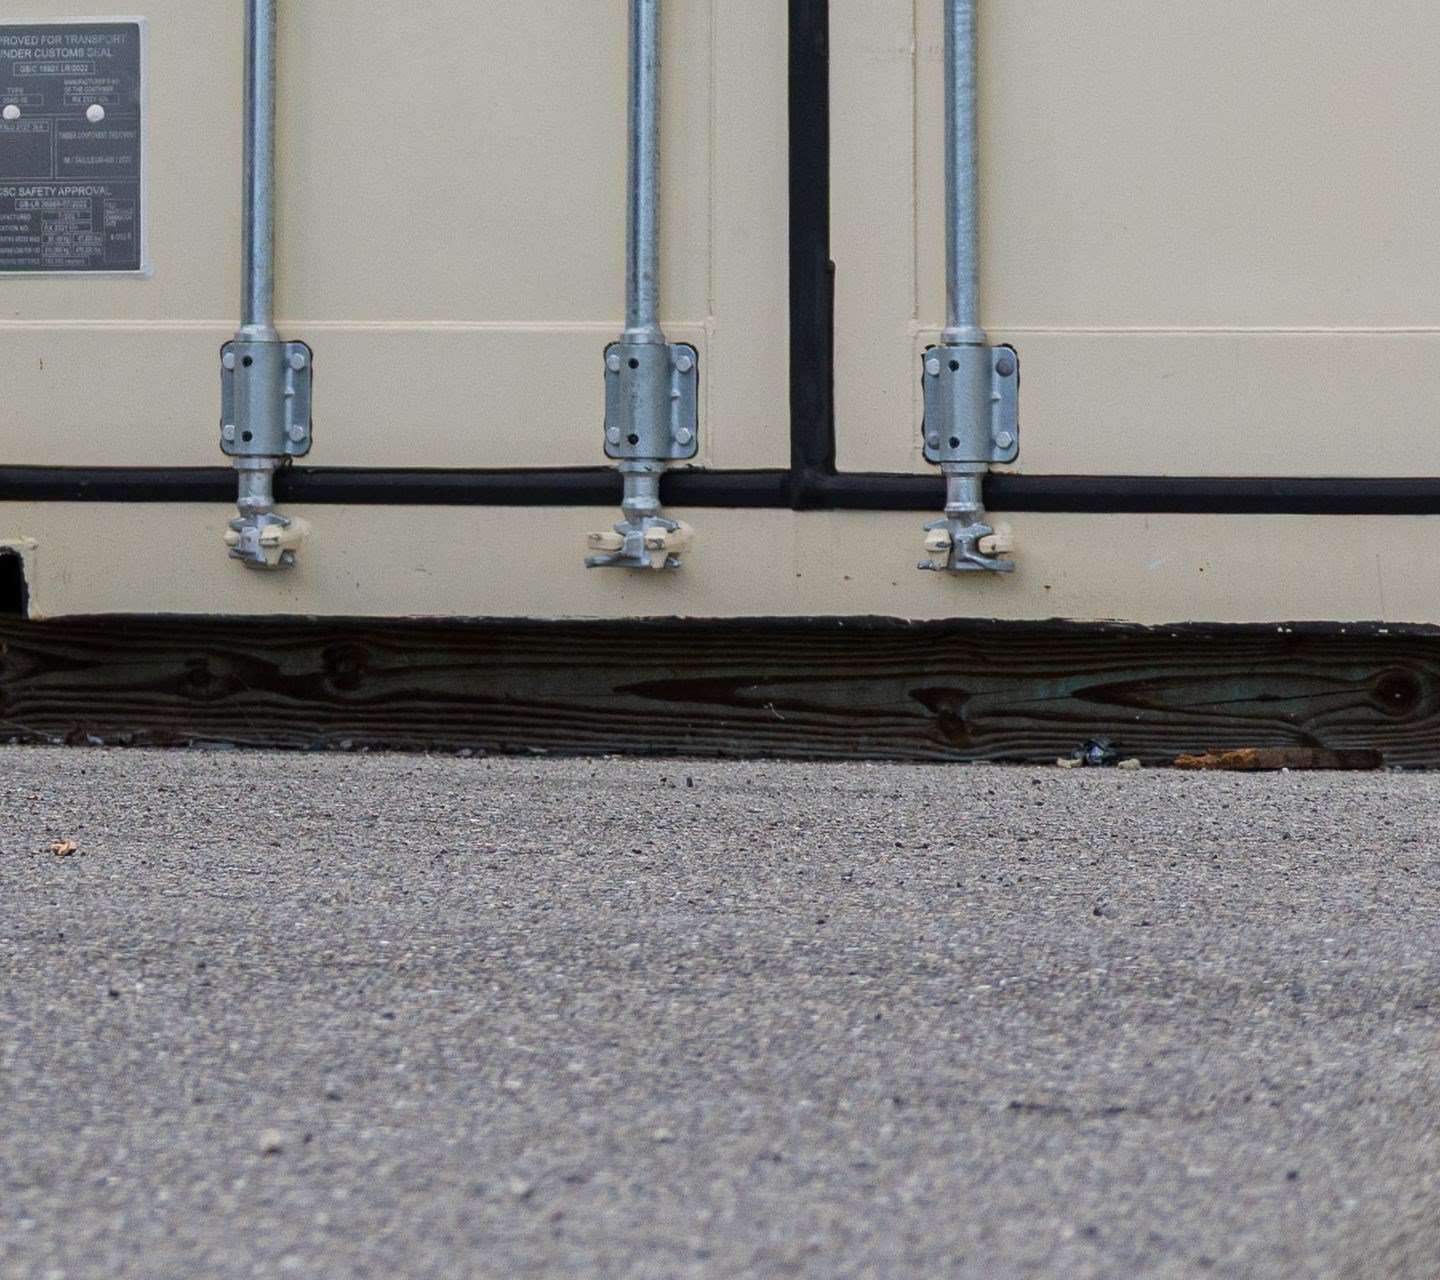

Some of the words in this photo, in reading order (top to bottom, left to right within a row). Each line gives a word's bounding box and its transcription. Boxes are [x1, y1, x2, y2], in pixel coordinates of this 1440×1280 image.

[41, 34, 63, 45] FOR
[65, 33, 126, 44] TRANSPORT
[34, 47, 84, 58] CUSTOMS
[87, 47, 113, 57] SEAL
[19, 186, 57, 197] SAFETY
